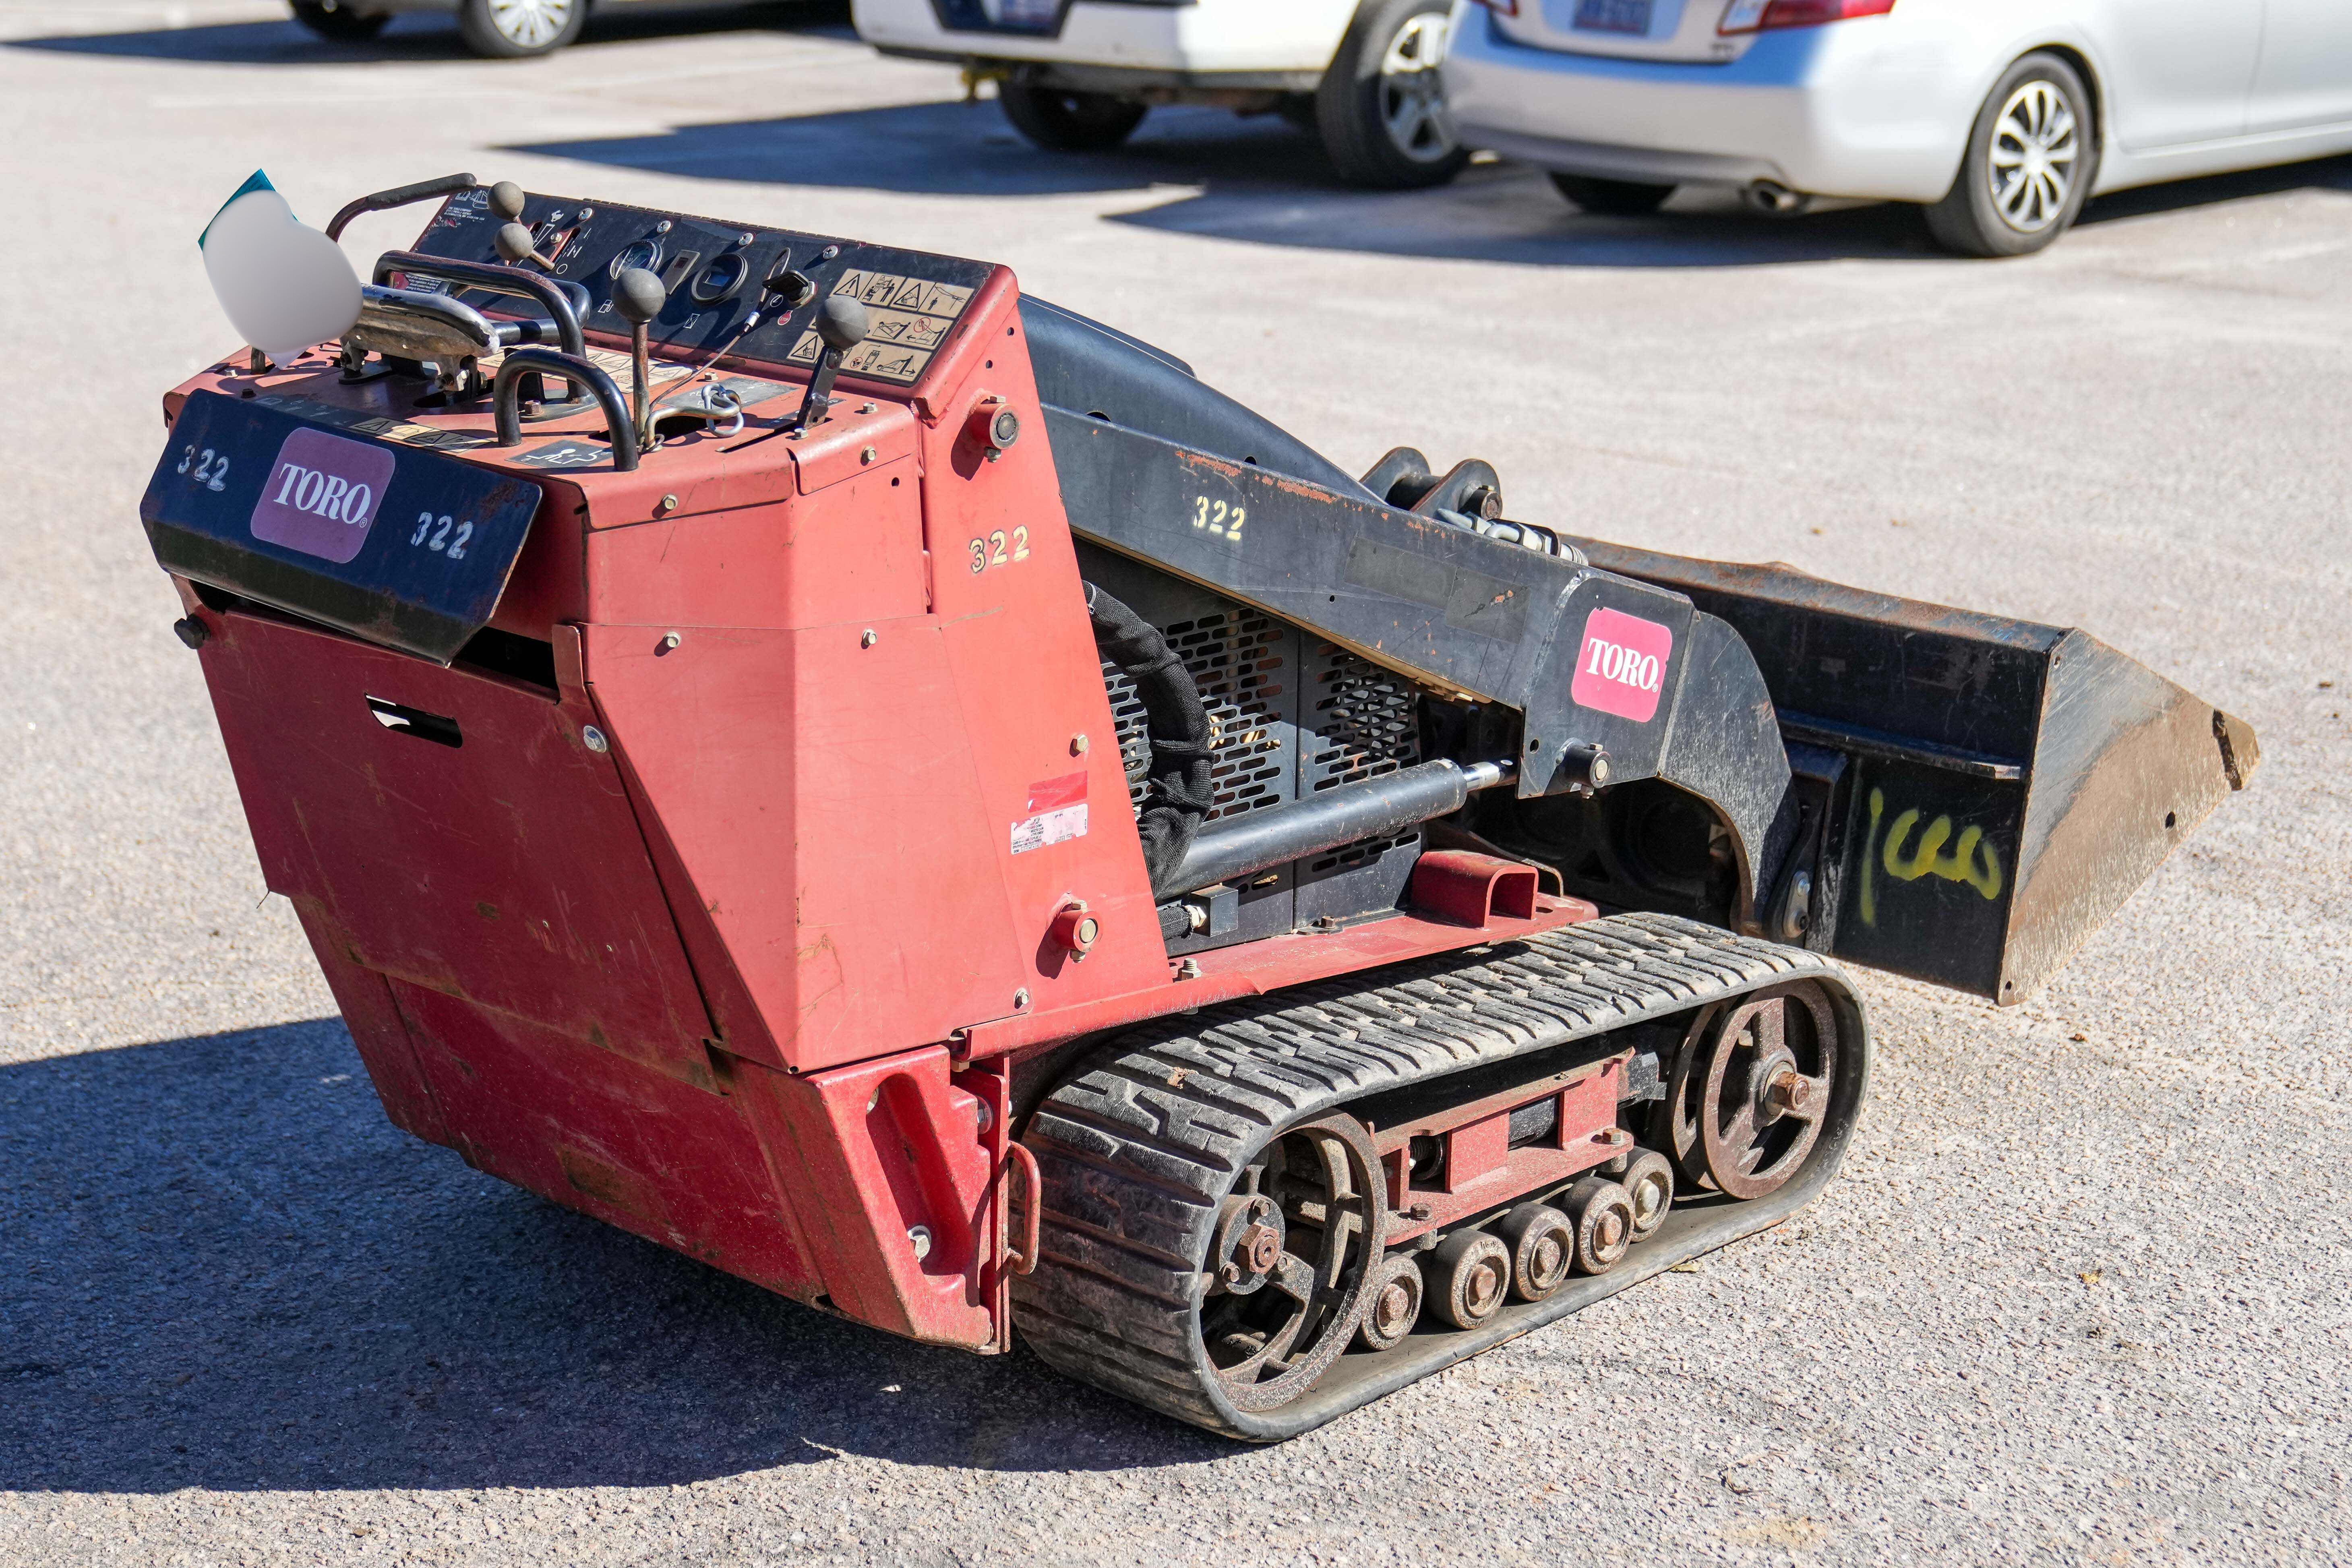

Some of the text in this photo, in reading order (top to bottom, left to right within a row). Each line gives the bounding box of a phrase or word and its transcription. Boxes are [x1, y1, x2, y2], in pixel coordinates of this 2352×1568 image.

[178, 445, 229, 492] 322
[273, 463, 371, 524] TORO
[410, 512, 474, 559] 322
[1194, 496, 1245, 541] 322
[969, 525, 1030, 574] 322
[1586, 637, 1659, 690] TORO
